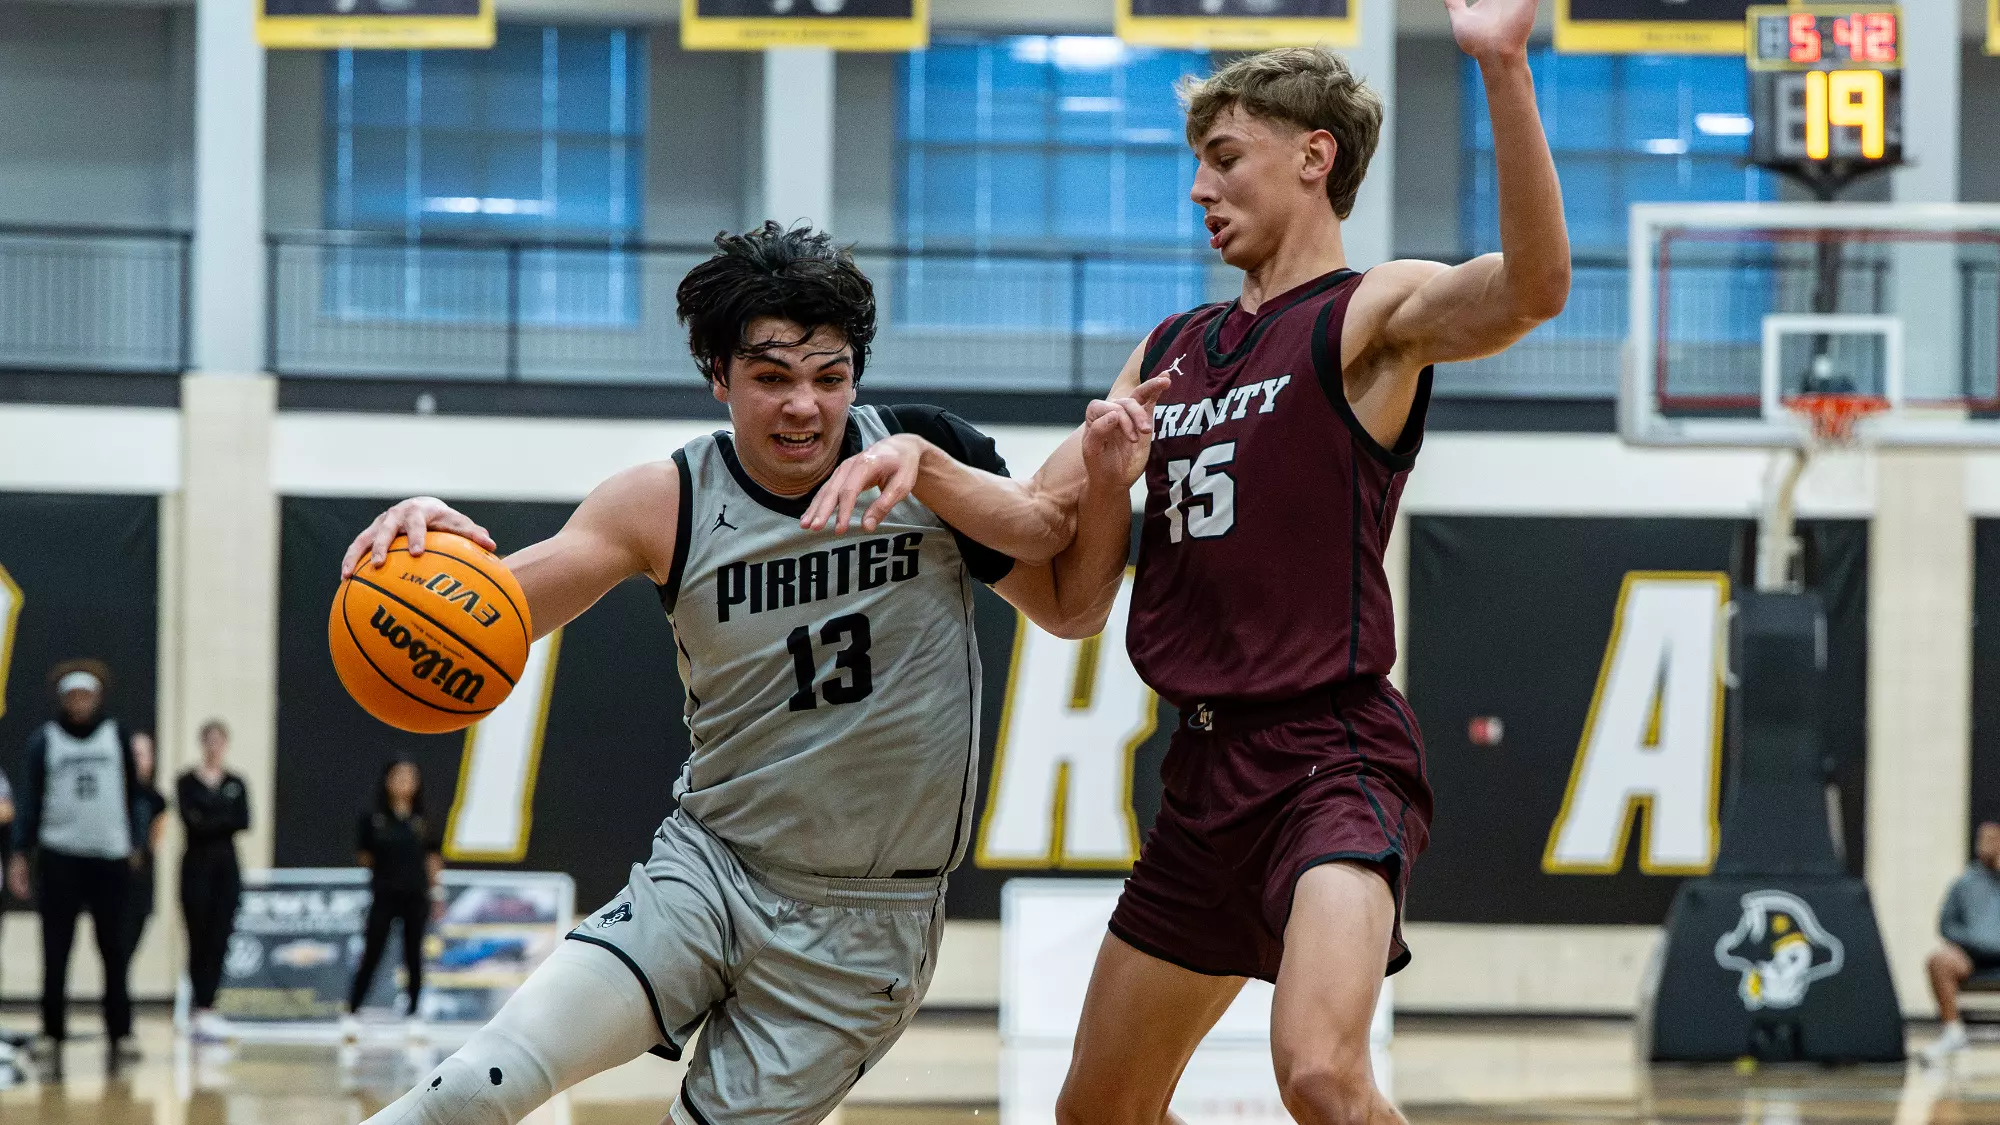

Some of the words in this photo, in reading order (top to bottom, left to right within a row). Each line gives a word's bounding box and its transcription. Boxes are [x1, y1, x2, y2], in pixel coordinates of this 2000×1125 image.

[1805, 70, 1884, 160] 19
[1164, 441, 1237, 544] 15
[399, 571, 427, 587] NXT
[424, 571, 501, 628] EVO
[716, 532, 924, 623] PIRATES
[369, 604, 485, 705] Wilson
[786, 612, 873, 712] 13
